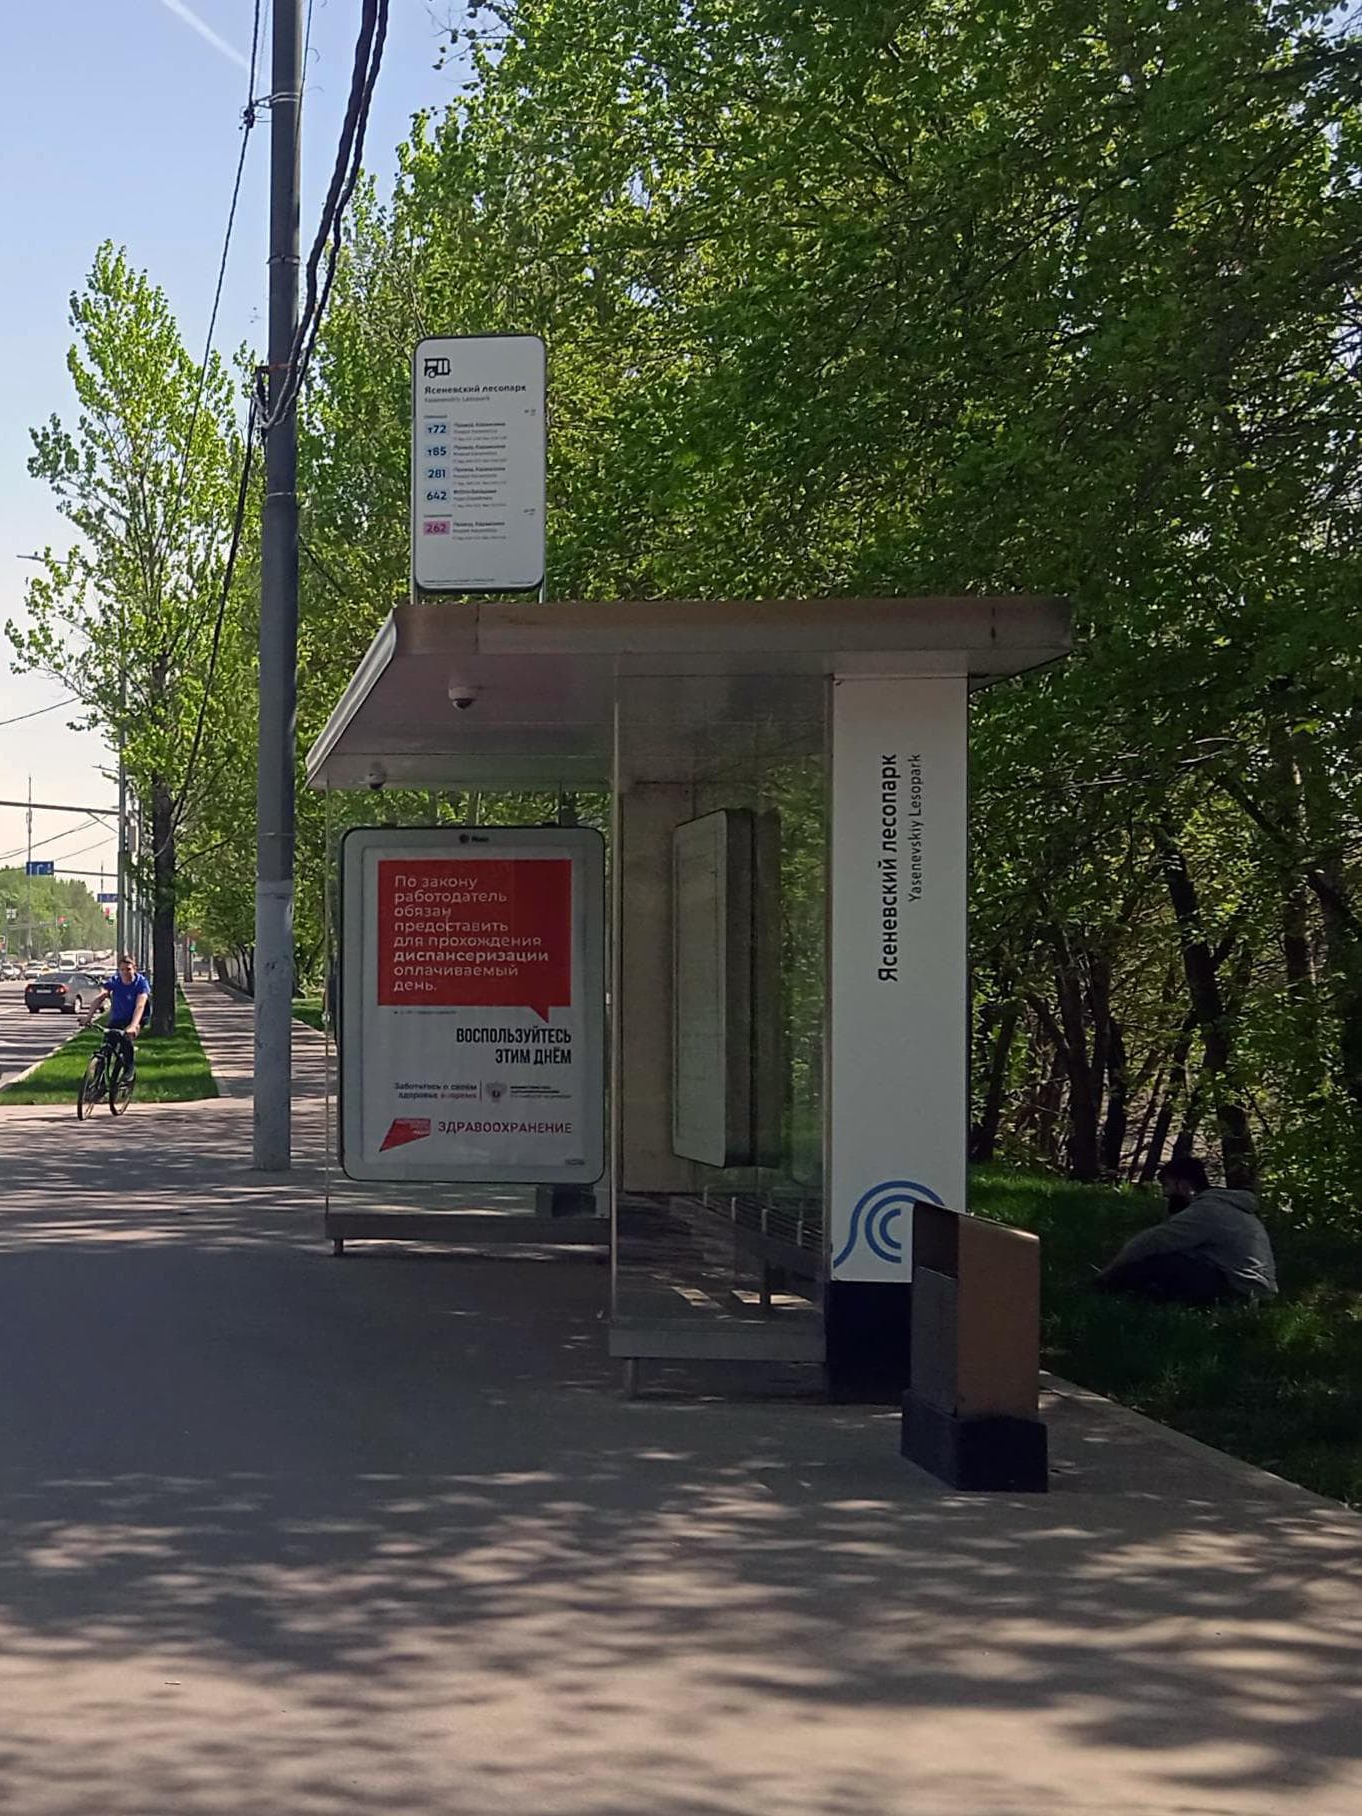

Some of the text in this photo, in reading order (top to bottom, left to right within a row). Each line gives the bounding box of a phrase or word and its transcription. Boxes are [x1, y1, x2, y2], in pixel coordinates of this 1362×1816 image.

[424, 384, 527, 394] Ясеневский лесопарк
[427, 469, 446, 478] 281
[426, 491, 447, 501] 642
[426, 523, 447, 533] 262
[907, 754, 924, 902] Yasenevskiy Lesopark
[878, 754, 901, 982] Ясеневский лесопарк
[394, 875, 478, 890] По закону
[394, 889, 507, 904] работодатель
[394, 904, 452, 917] обязан
[394, 921, 509, 933] предоставить
[393, 936, 542, 949] для прохождения
[393, 951, 549, 964] диспансеризации
[393, 964, 519, 977] оплачиваемый
[393, 981, 437, 992] день.
[456, 1025, 572, 1044] ВОСПОЛЬЗУЙТЕСЬ
[495, 1047, 572, 1065] ЭТИМ ДНЁМ
[438, 1121, 572, 1135] ЗДРАВООХРАНЕНИЕ
